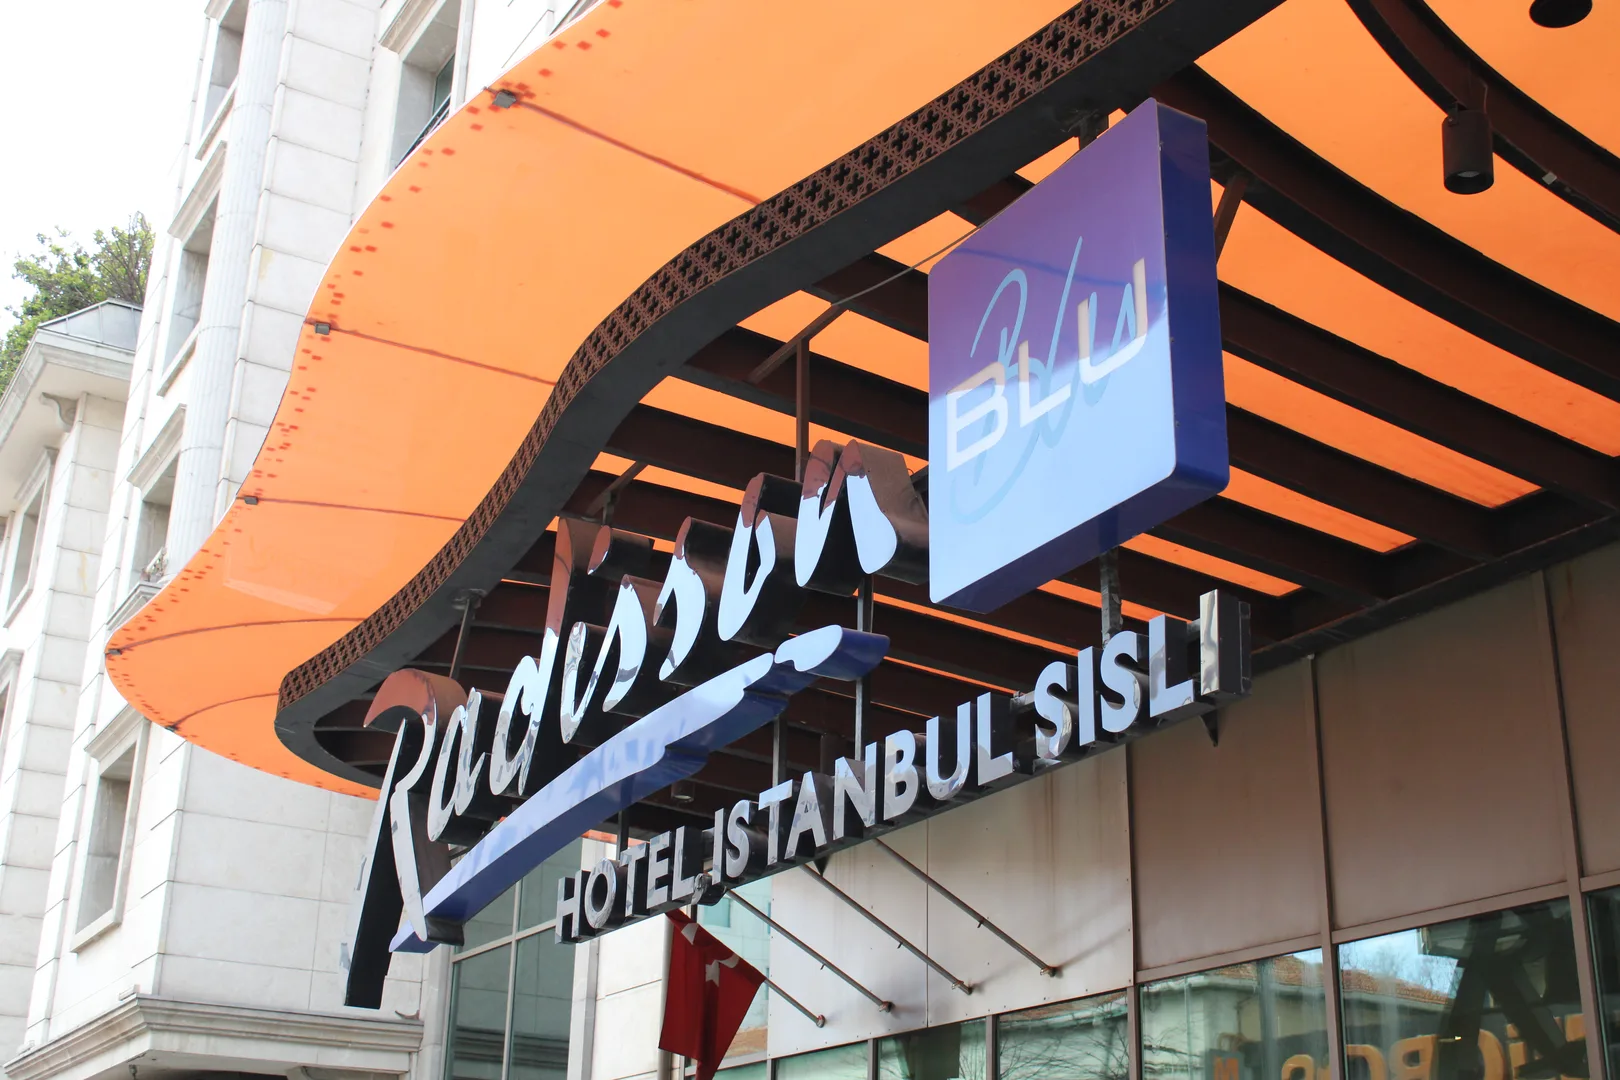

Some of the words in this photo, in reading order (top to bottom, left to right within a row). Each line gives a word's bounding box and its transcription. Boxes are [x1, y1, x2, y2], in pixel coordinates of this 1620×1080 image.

[946, 257, 1147, 472] BLU
[342, 439, 898, 1008] Radisson
[555, 825, 696, 944] HOTEL
[712, 692, 1013, 885] ISTANBUL
[1034, 589, 1219, 759] SISLI
